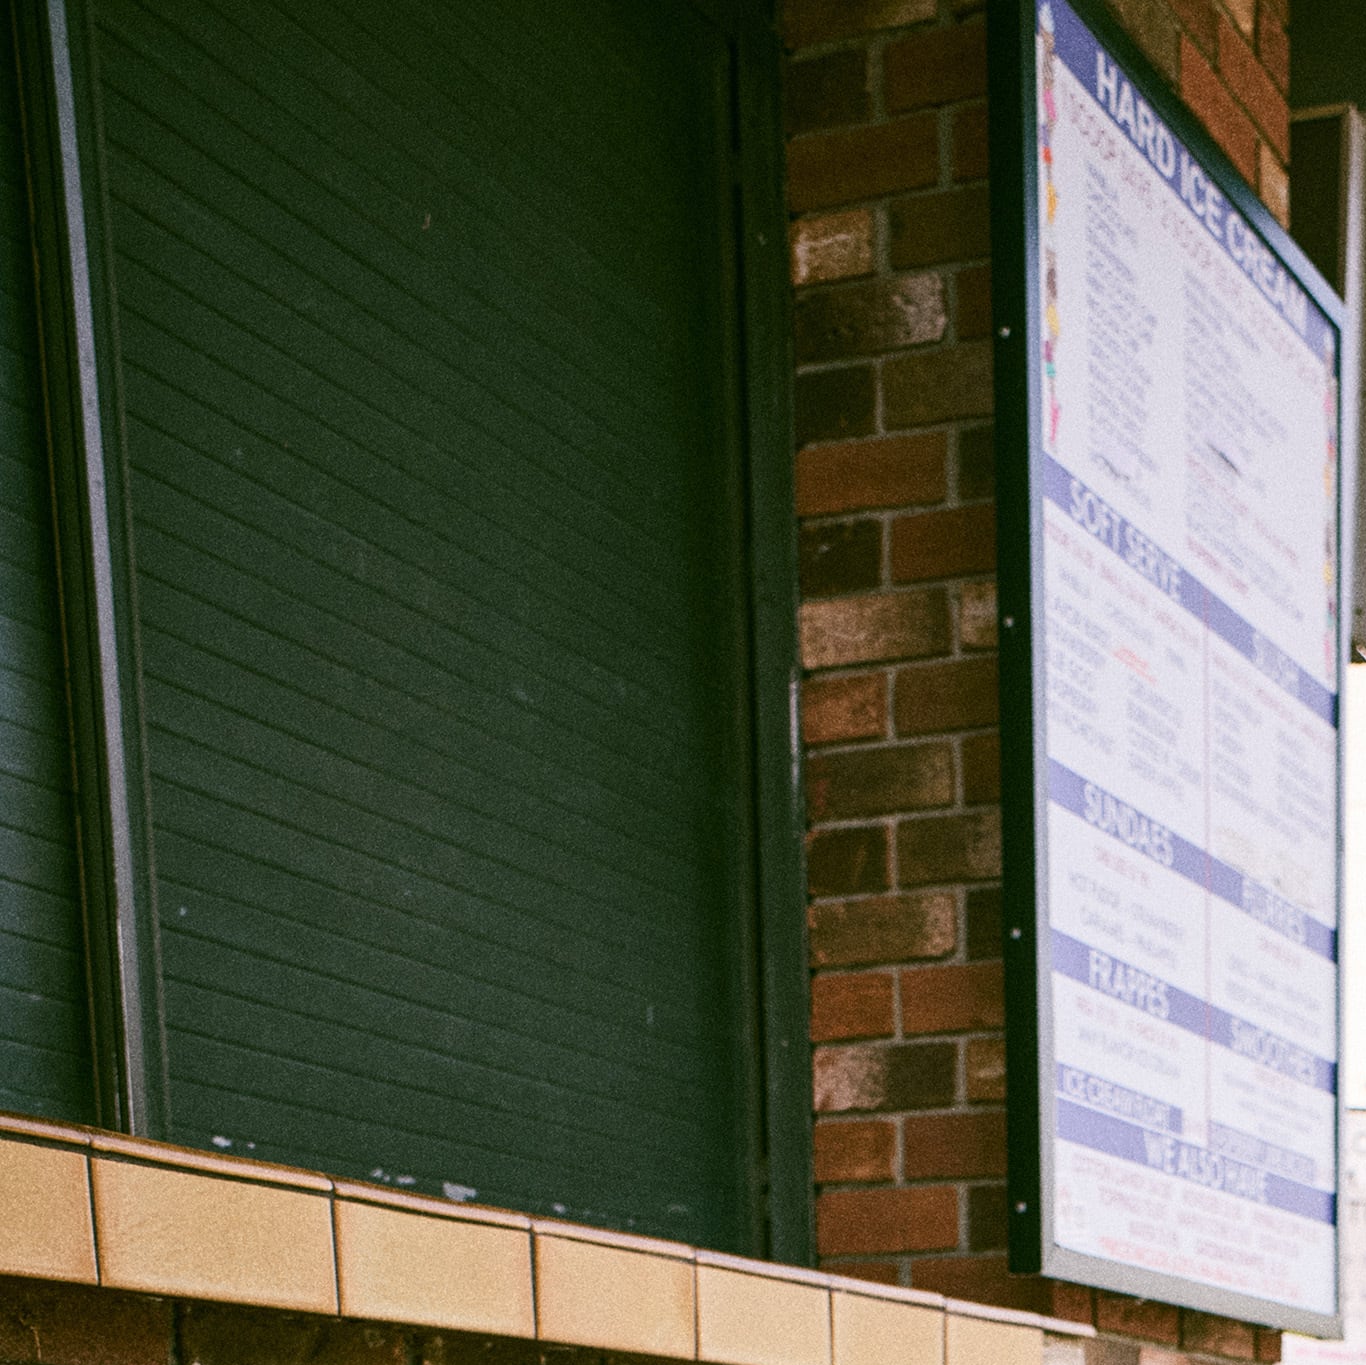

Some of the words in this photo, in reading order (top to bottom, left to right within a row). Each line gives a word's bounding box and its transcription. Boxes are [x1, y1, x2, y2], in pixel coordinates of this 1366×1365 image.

[1096, 49, 1175, 179] HARD
[1179, 152, 1224, 237] ICE
[1225, 212, 1307, 333] CREAM
[1069, 479, 1120, 551] SOFT
[1126, 524, 1181, 603] SERVE
[1083, 783, 1174, 867] SUNDAES
[1088, 950, 1170, 1020] FRAPPES
[1143, 1131, 1175, 1175] WE
[1177, 1141, 1224, 1190] ALSO
